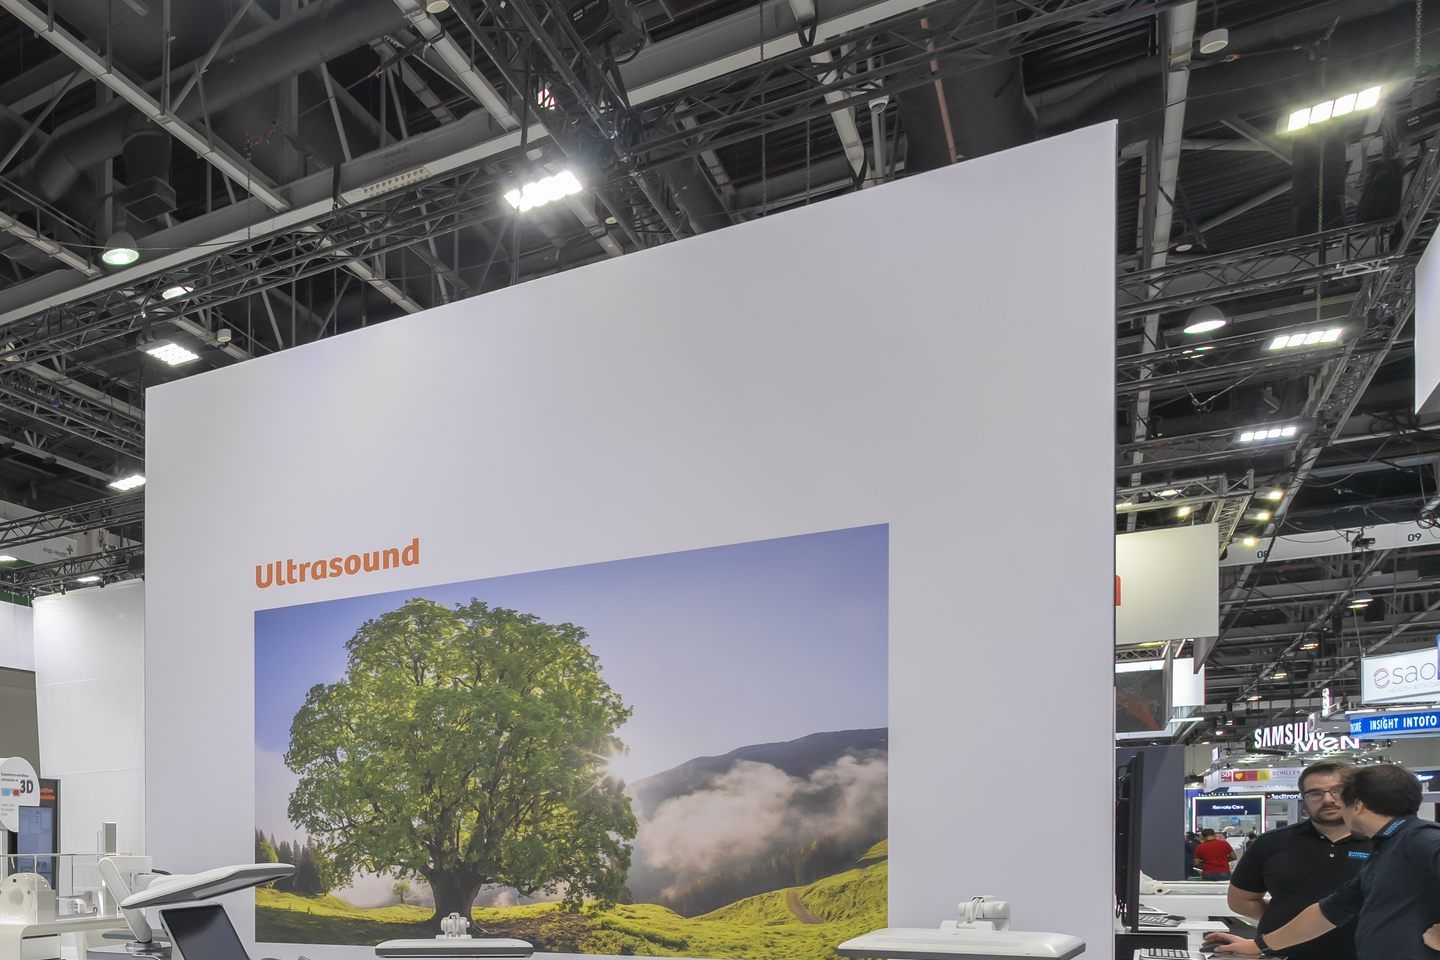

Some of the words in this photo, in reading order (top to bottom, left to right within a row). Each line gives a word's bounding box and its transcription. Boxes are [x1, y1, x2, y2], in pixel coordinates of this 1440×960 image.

[1407, 532, 1422, 543] 09
[255, 537, 420, 589] Ultrasound
[1254, 721, 1327, 749] SAMSU
[19, 779, 34, 794] 3D
